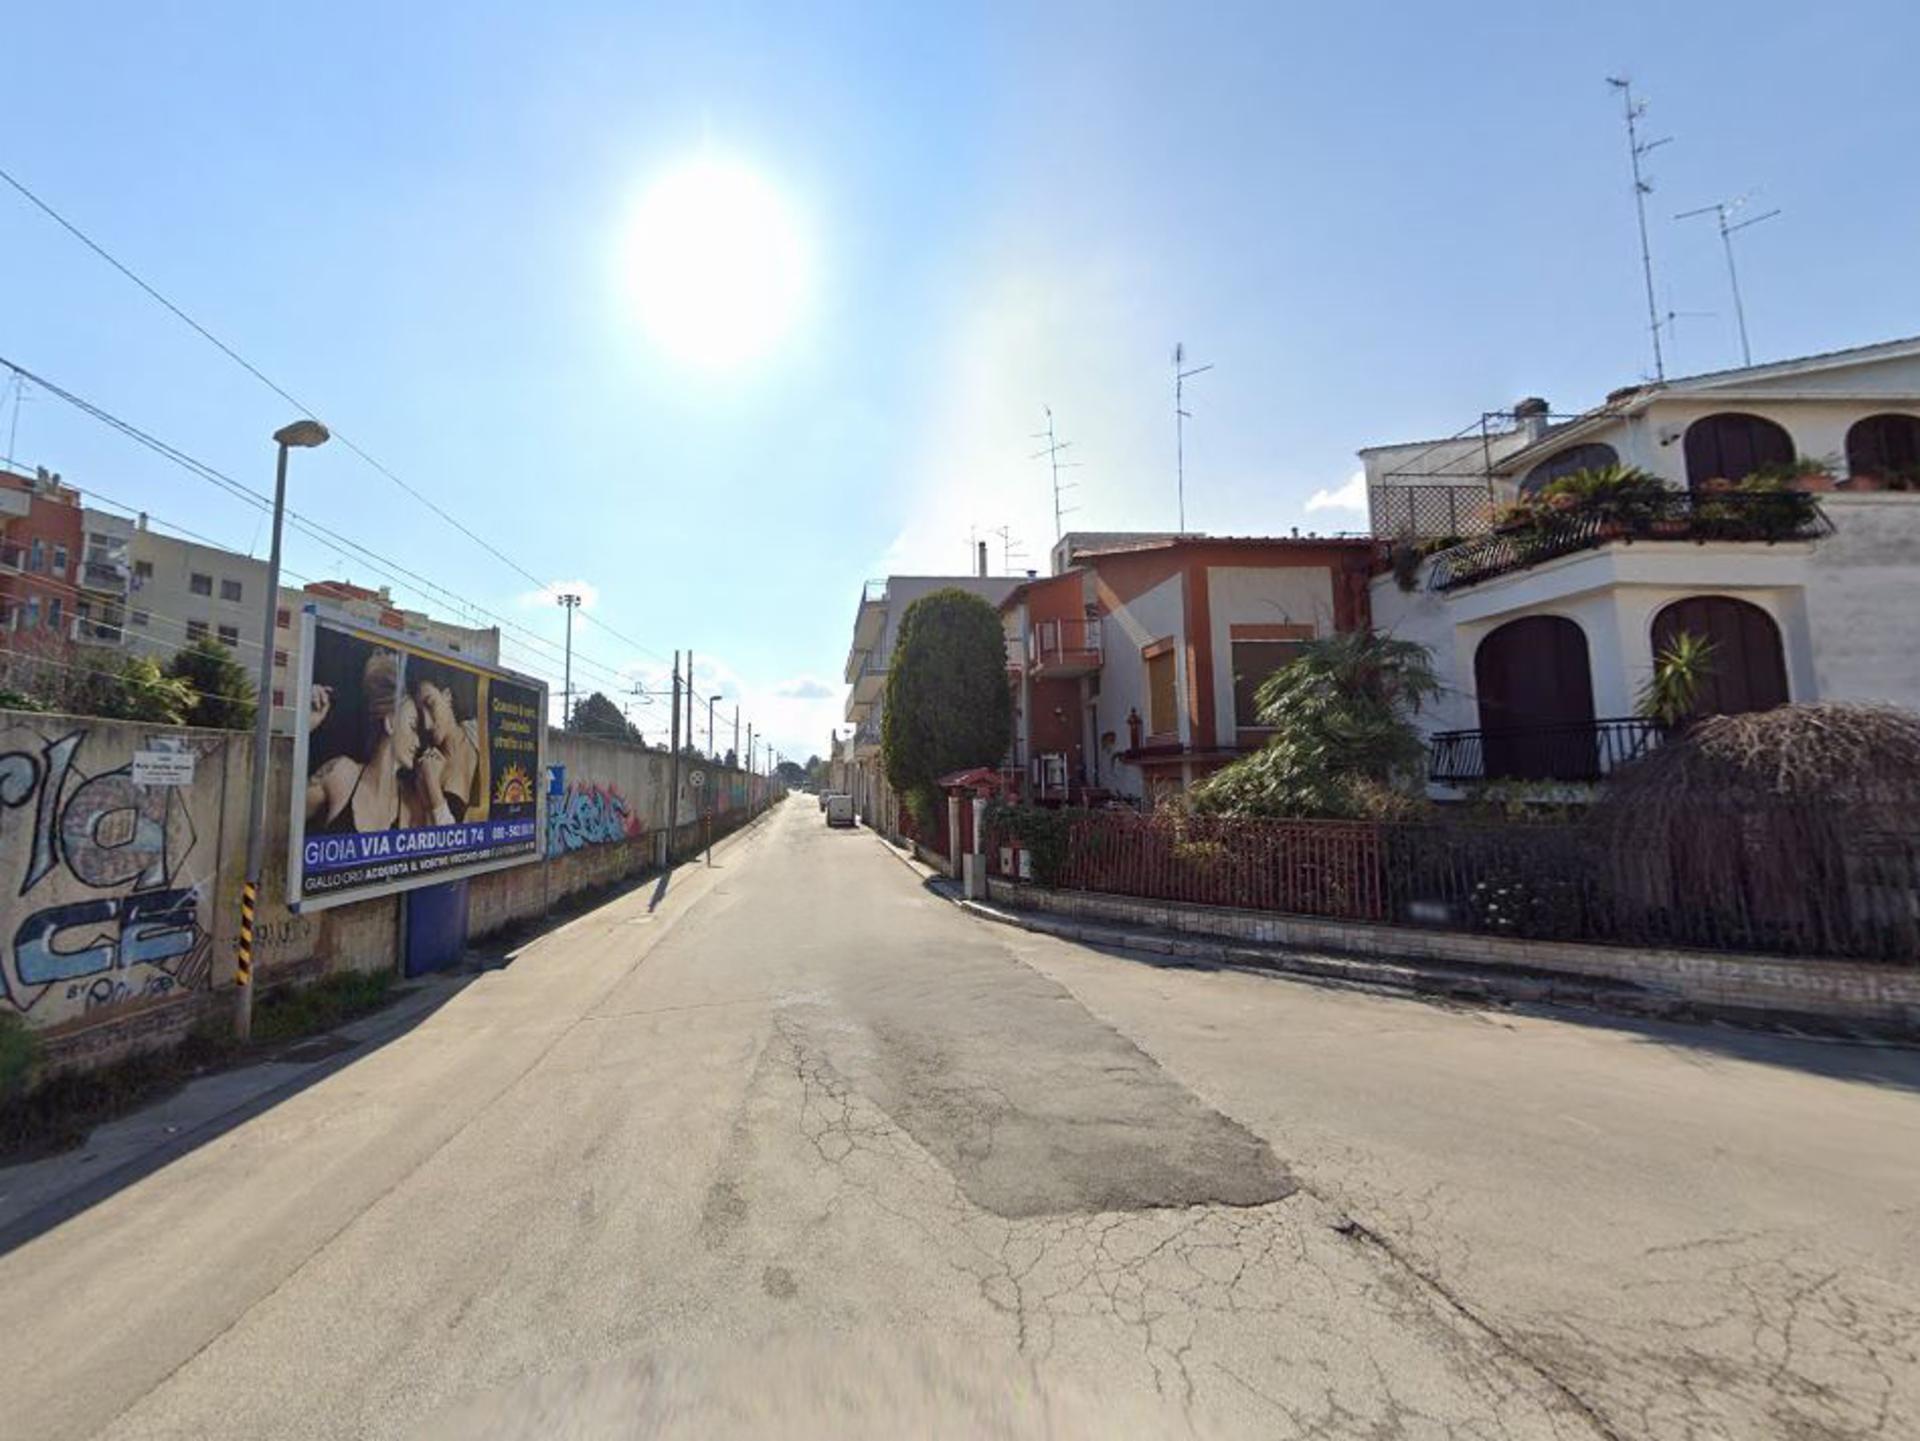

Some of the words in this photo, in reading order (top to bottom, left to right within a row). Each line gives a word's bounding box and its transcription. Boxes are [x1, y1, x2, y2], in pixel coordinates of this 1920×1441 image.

[304, 839, 357, 865] GIOIA
[361, 835, 391, 857] VIA
[395, 828, 467, 853] CARDUCCI
[470, 827, 484, 844] 74
